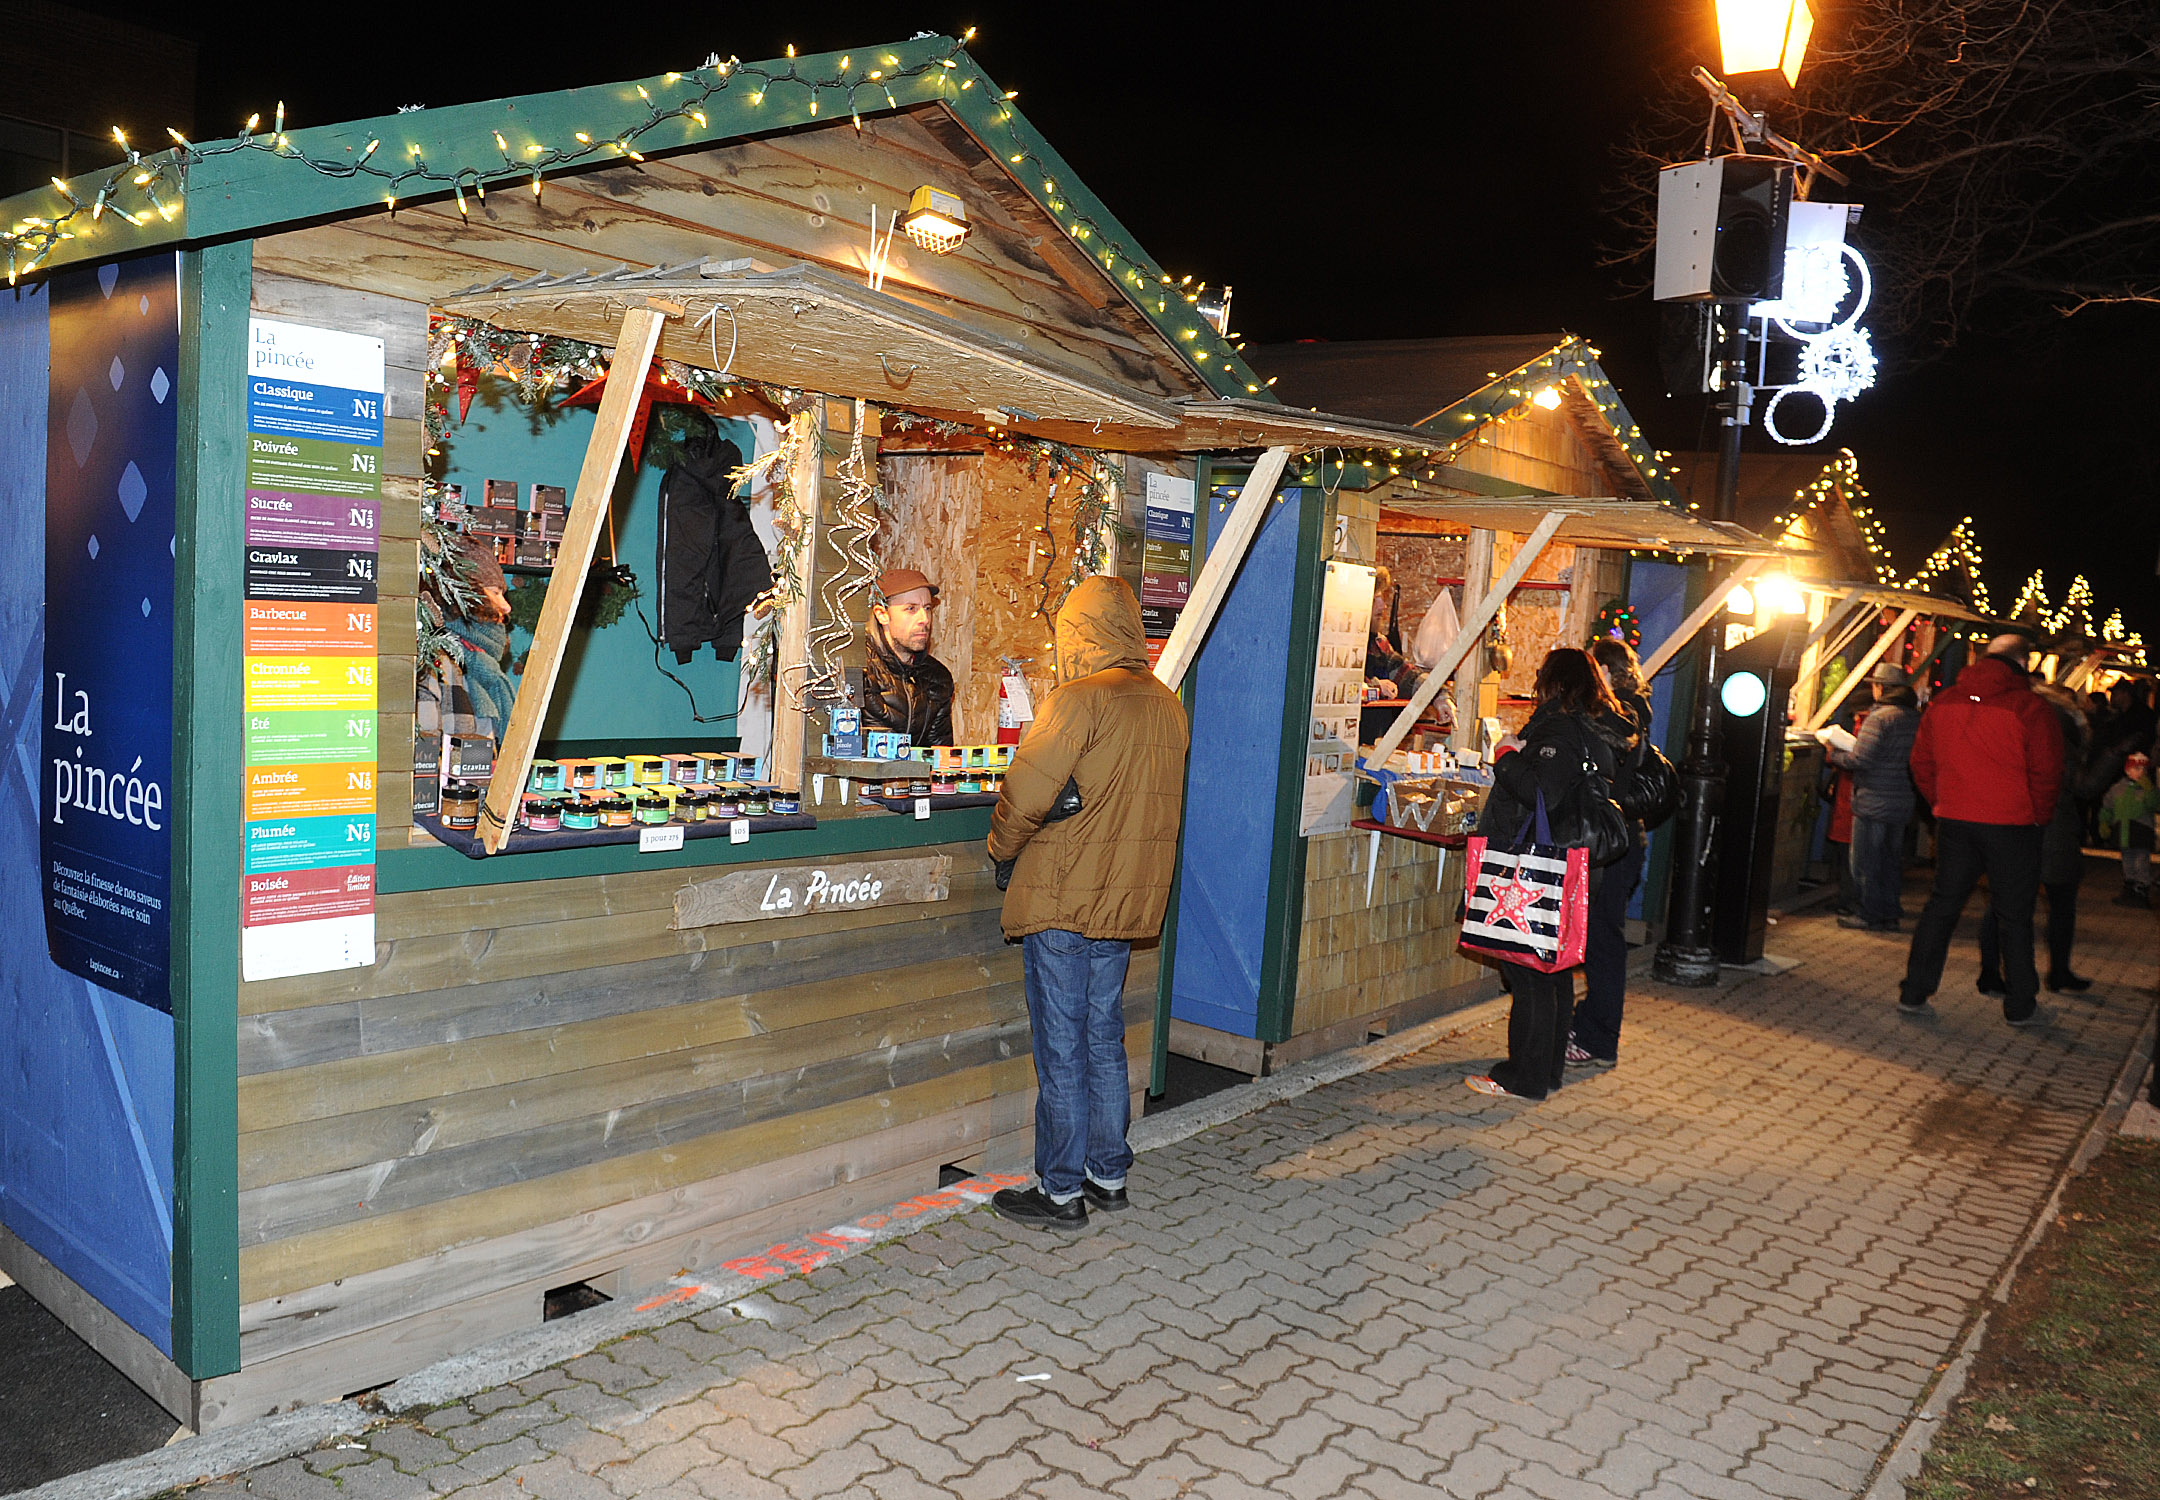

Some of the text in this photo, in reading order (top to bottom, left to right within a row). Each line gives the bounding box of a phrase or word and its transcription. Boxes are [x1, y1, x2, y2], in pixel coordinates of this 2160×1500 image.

[255, 327, 275, 345] La
[255, 348, 314, 369] pincée
[253, 382, 314, 401] Classique
[252, 439, 299, 455] Poivrée
[1149, 477, 1158, 488] La
[1149, 489, 1170, 502] pincée
[250, 496, 293, 511] Sucrée
[249, 550, 298, 564] Gravlax
[250, 607, 307, 620] Barbecue
[250, 662, 311, 675] Citronnée
[55, 672, 93, 737] La
[251, 717, 270, 730] Été
[461, 763, 491, 771] Gravlax
[252, 770, 298, 784] Ambrée
[53, 745, 163, 832] pincée
[251, 824, 296, 839] Plumée
[650, 835, 667, 844] pour
[668, 834, 679, 842] 27$
[734, 828, 746, 836] 10$
[53, 860, 162, 911] Découvrez la finesse de nos saveurs
[250, 877, 289, 892] Boisée
[347, 874, 371, 883] Édition
[347, 882, 371, 892] limitée
[760, 870, 883, 911] La Pincée
[53, 877, 151, 925] de fantaisie élaborées avec soin
[53, 898, 88, 921] au Québec.
[89, 958, 120, 980] lapincee.ca
